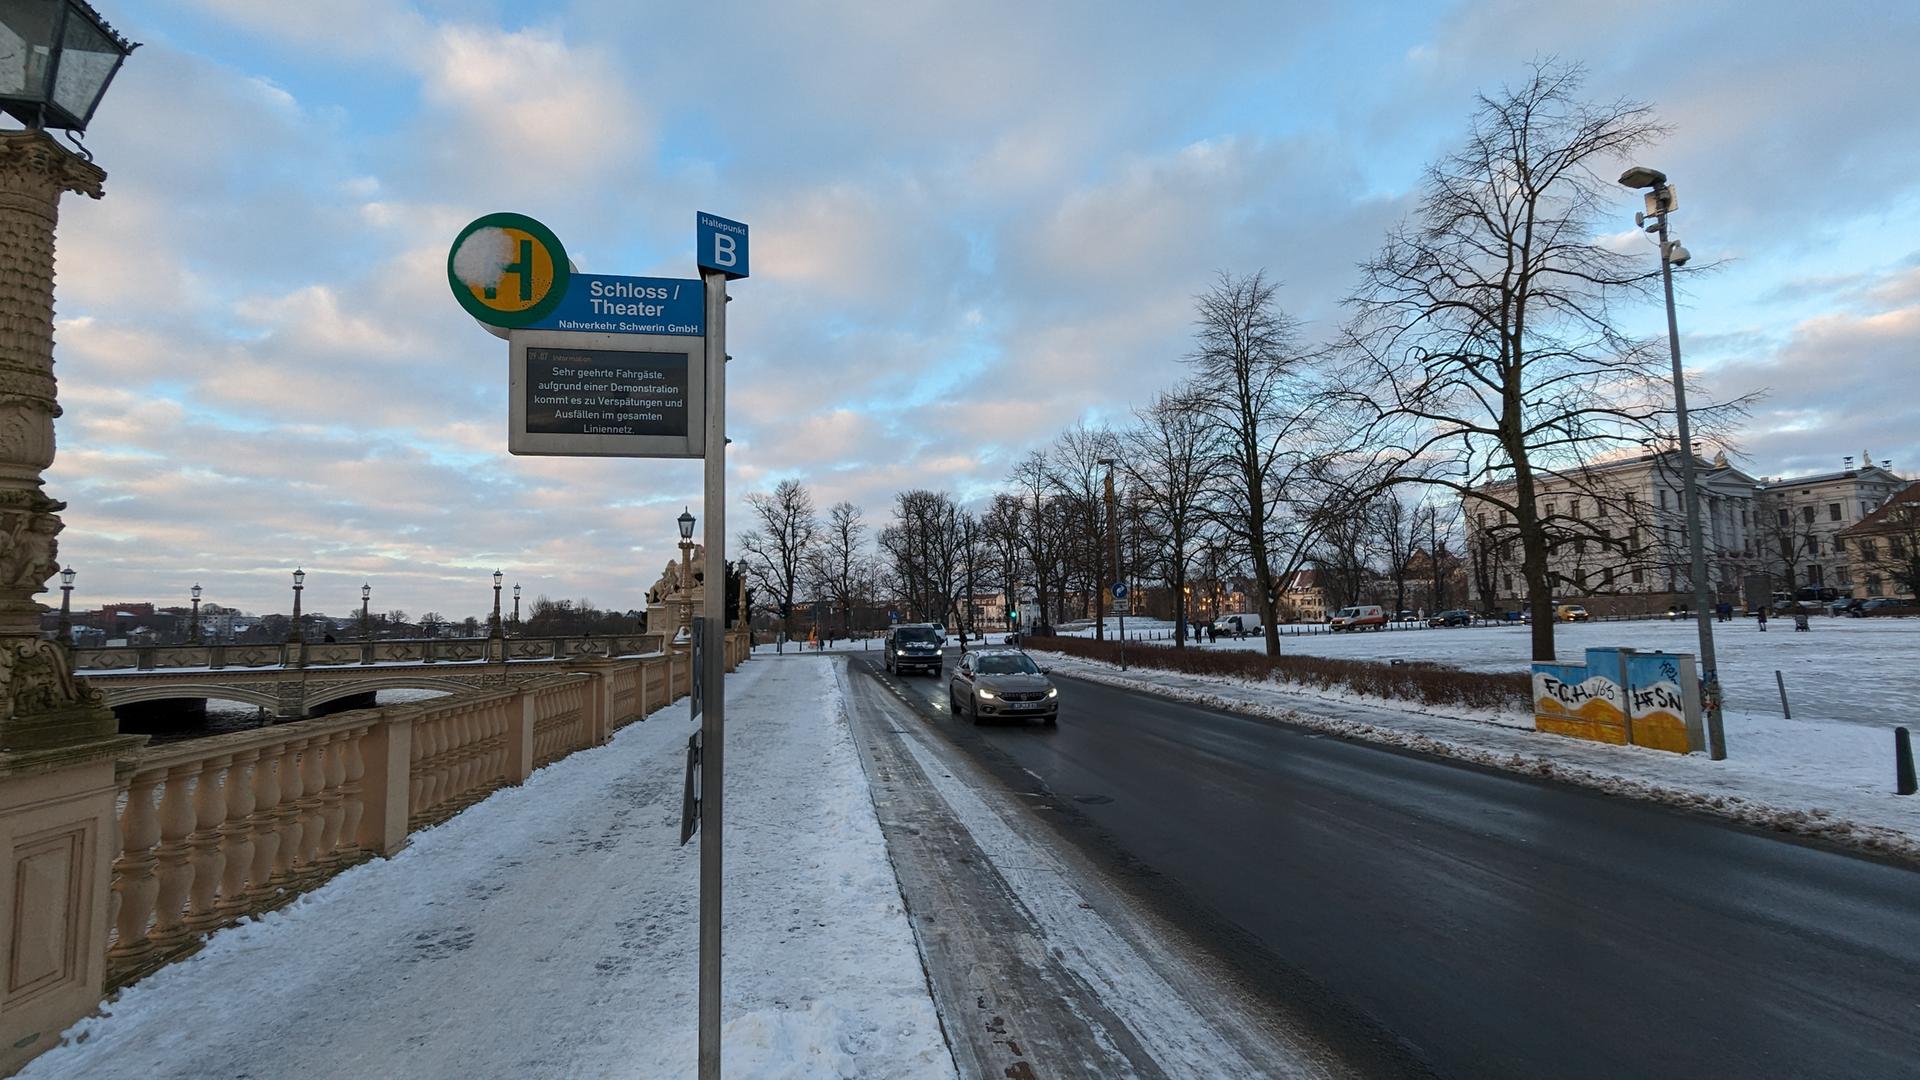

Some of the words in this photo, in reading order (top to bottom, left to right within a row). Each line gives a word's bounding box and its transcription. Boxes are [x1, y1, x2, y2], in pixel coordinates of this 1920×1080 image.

[701, 216, 746, 236] Haltepunkt
[714, 232, 737, 267] B
[590, 281, 668, 300] Schloss
[673, 284, 680, 300] /
[590, 299, 665, 317] Theater
[559, 320, 617, 330] Nahverkehr
[619, 322, 665, 332] Schwerin
[667, 324, 698, 333] GmbH
[552, 367, 575, 377] Sehr
[578, 368, 614, 379] geehrte
[538, 381, 581, 392] aufgrund
[584, 382, 608, 391] einer
[611, 383, 679, 394] Demonstration
[534, 396, 568, 405] kommt
[598, 397, 663, 409] Verspätungen
[665, 399, 683, 408] und
[554, 409, 600, 419] Ausfällen
[602, 410, 614, 420] im
[617, 411, 663, 422] gesamten
[583, 424, 635, 435] Liniennetz.
